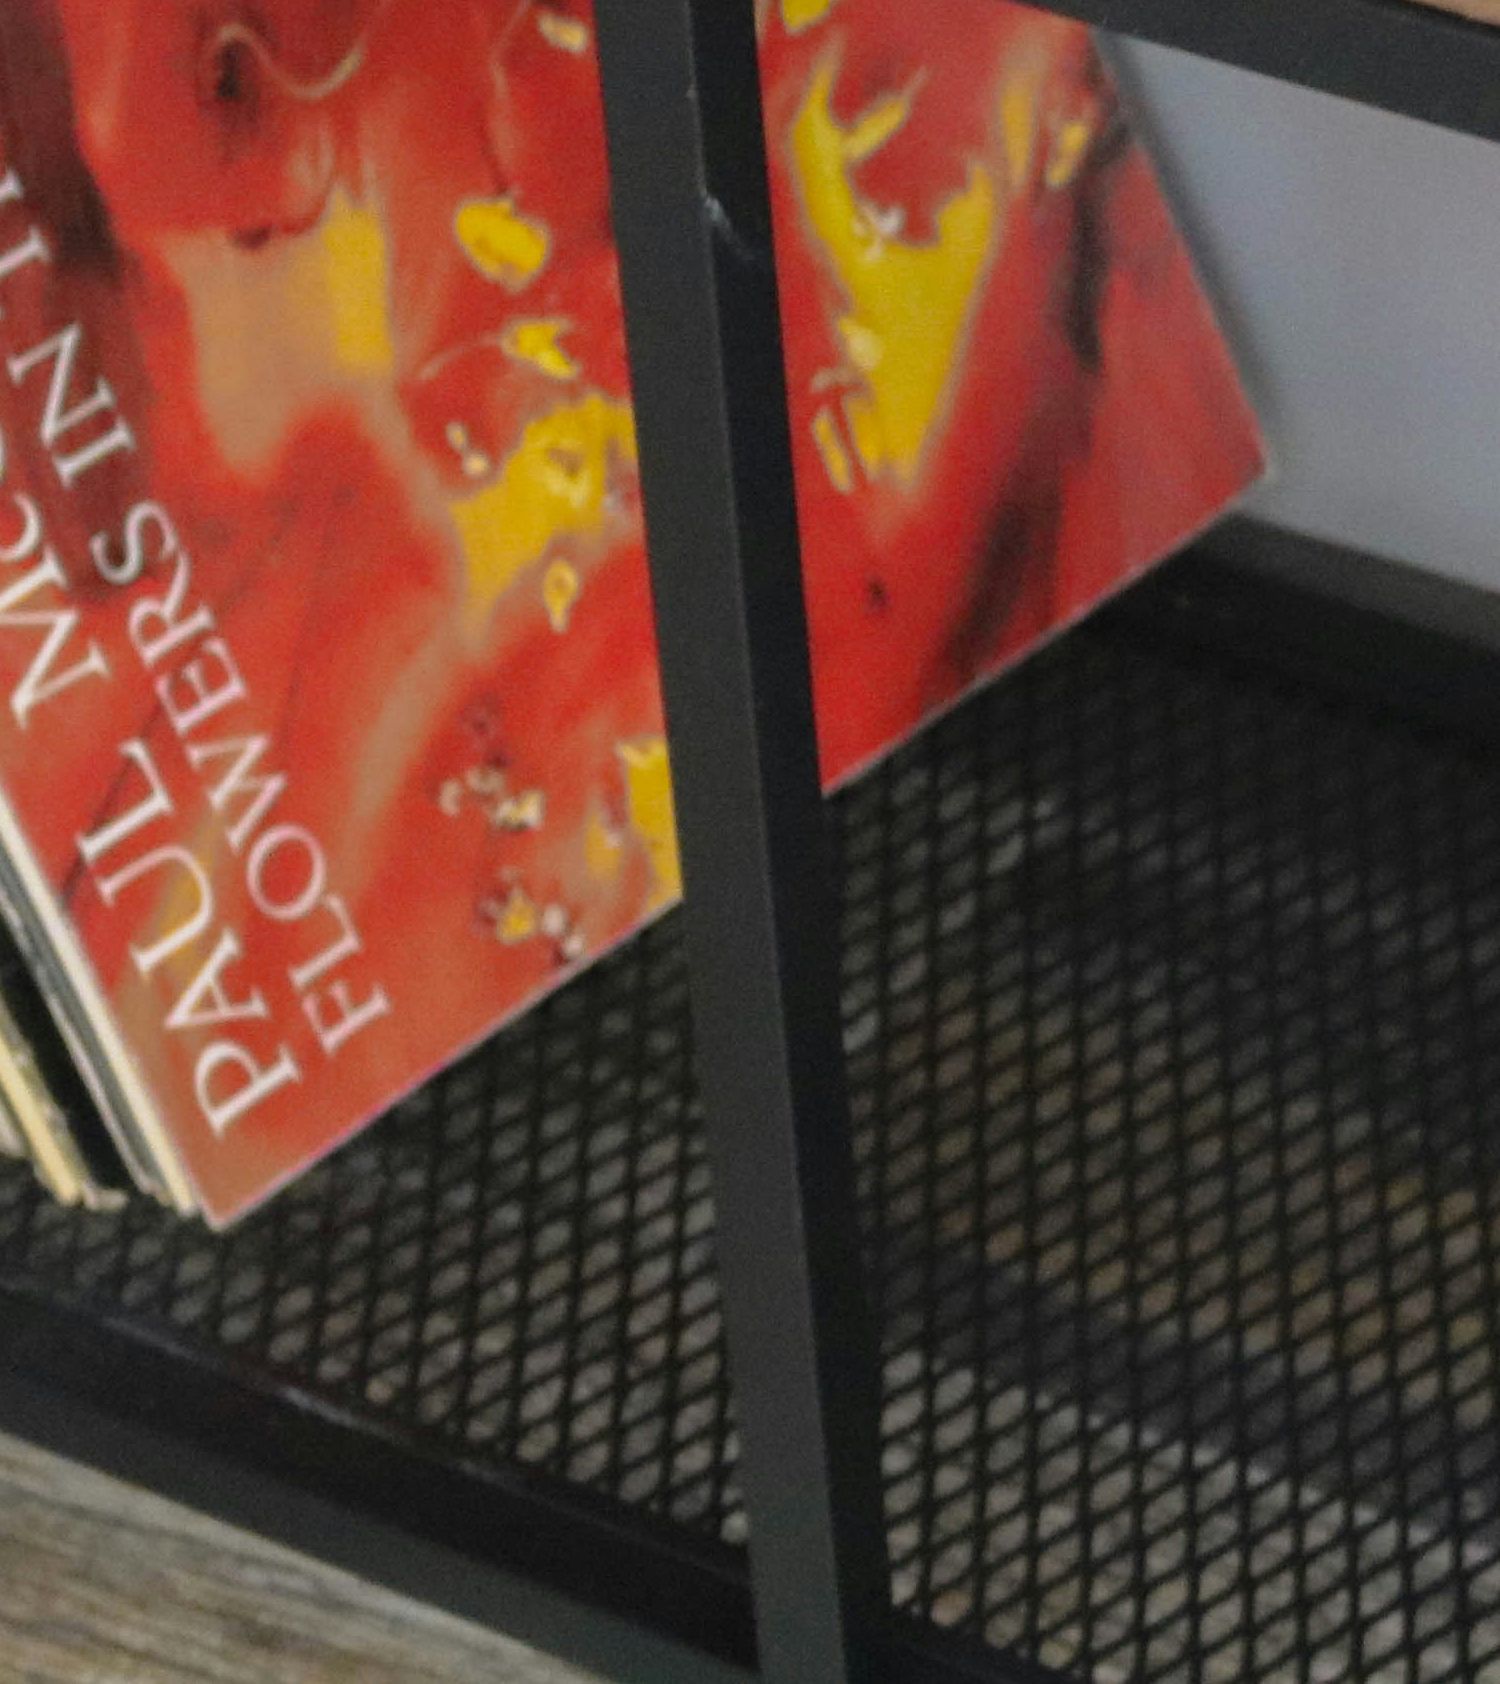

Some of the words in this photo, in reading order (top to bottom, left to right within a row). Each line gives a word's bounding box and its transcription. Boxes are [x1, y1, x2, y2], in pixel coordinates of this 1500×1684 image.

[8, 322, 134, 486] IN
[78, 742, 299, 1135] PAUL
[92, 501, 390, 1056] FLOWERS
